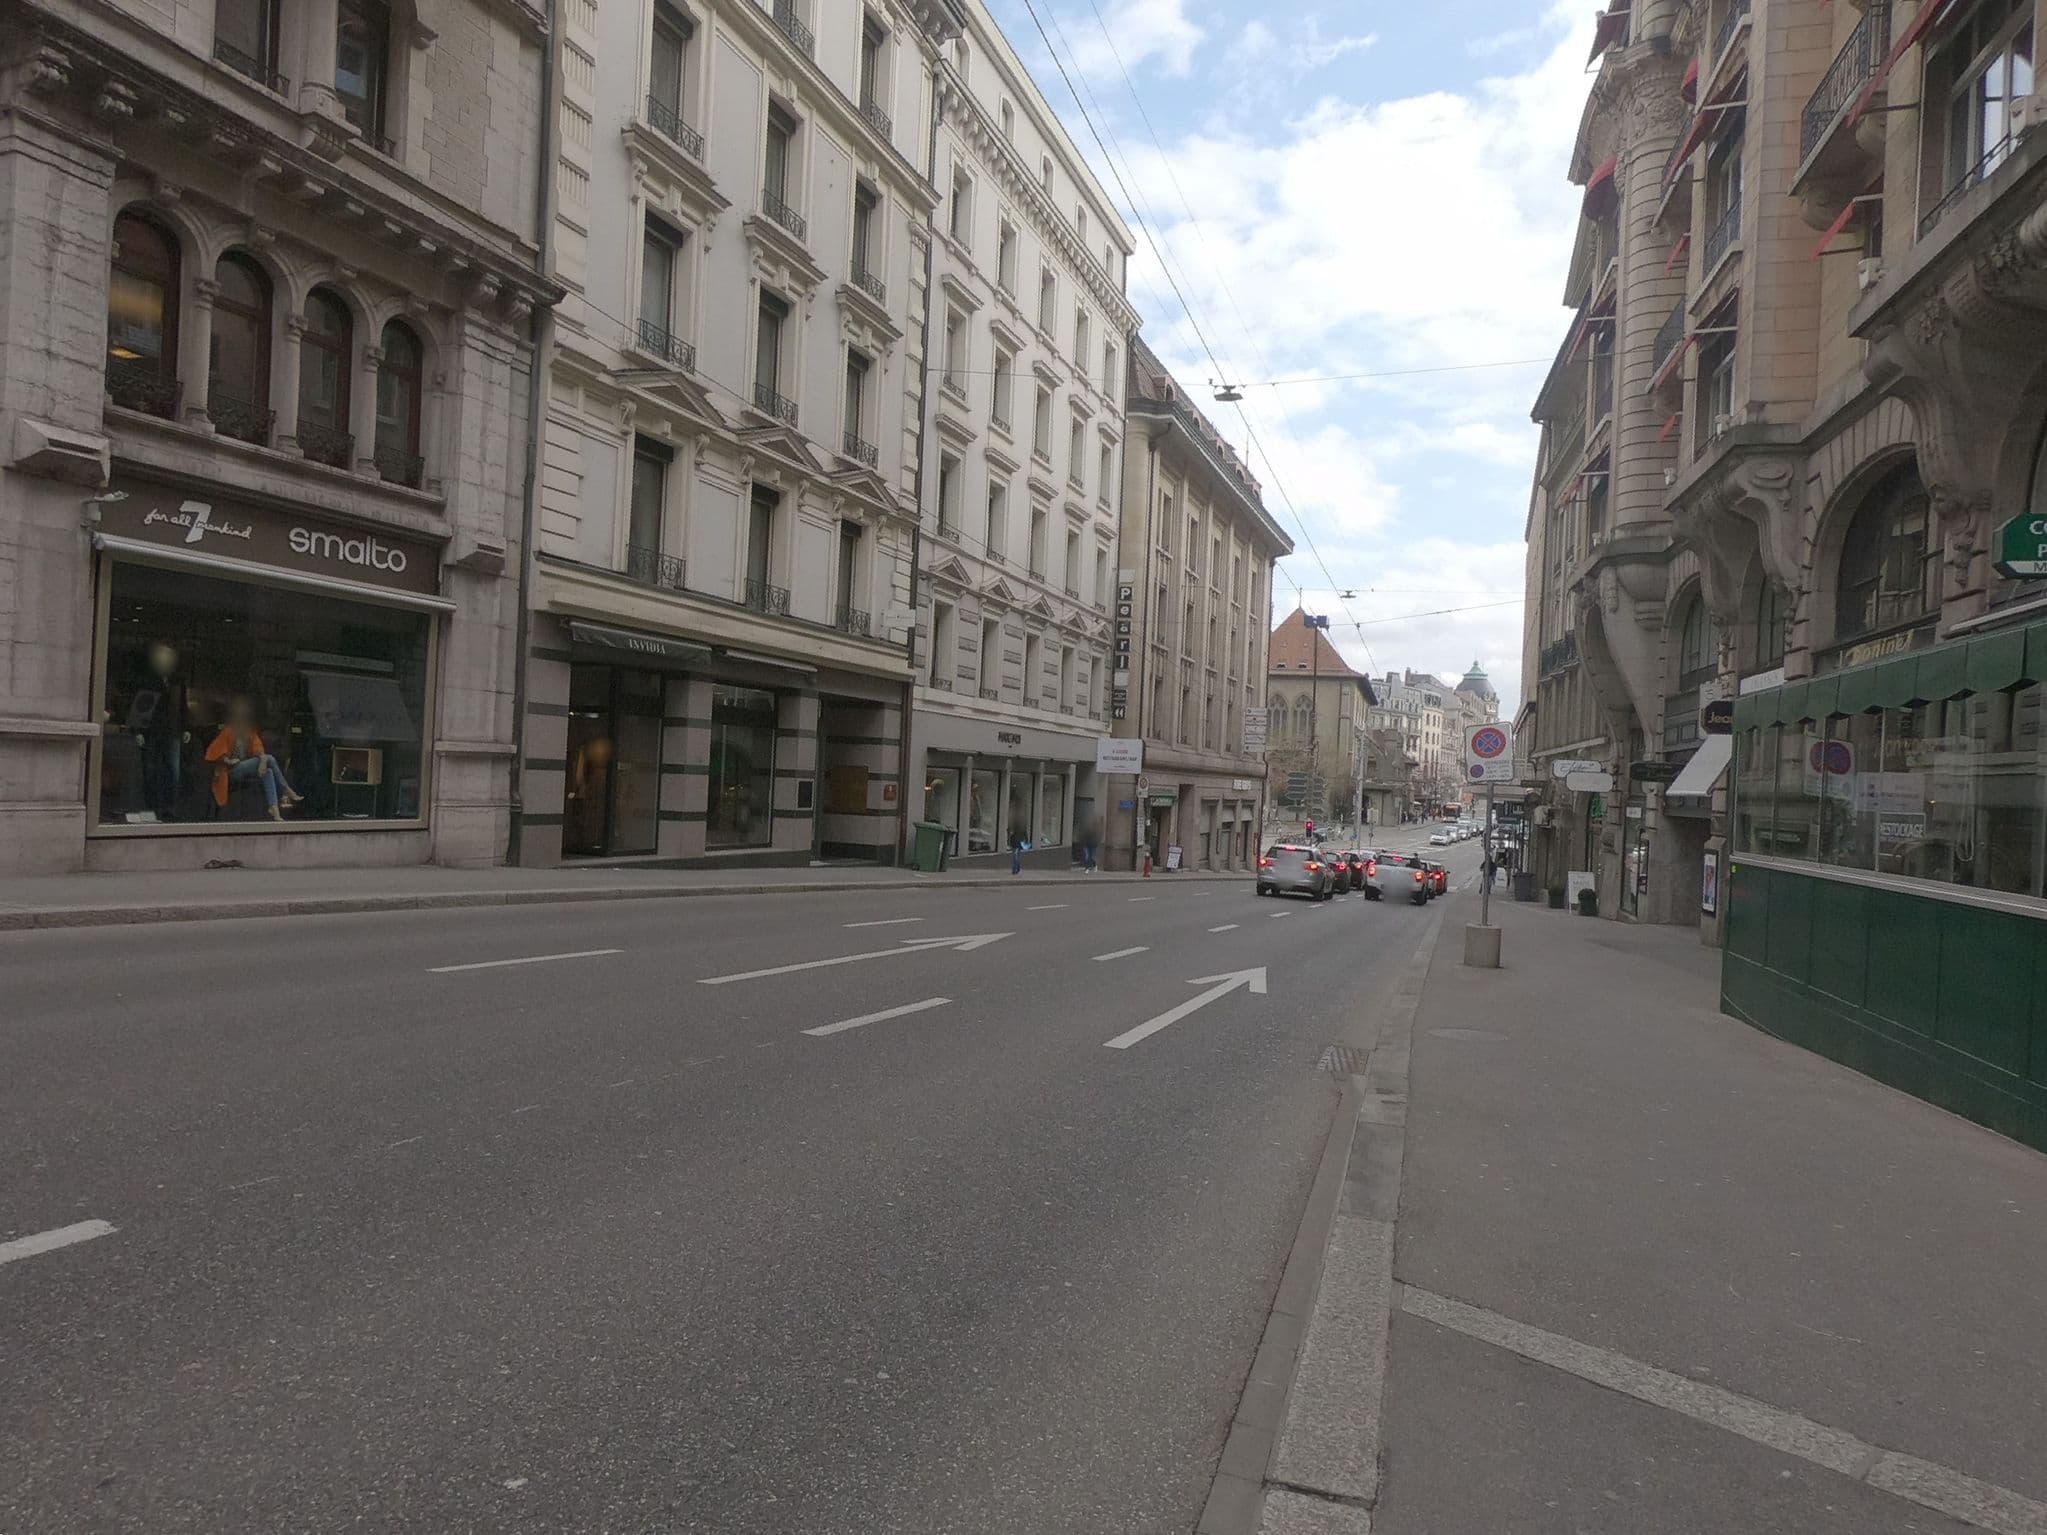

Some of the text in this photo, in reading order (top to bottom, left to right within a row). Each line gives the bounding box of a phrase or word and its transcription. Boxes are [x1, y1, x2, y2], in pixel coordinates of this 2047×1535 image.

[144, 500, 252, 544] for all 7 mankind
[2029, 520, 2047, 535] C
[288, 527, 407, 573] smalto
[1119, 587, 1131, 669] Pearl
